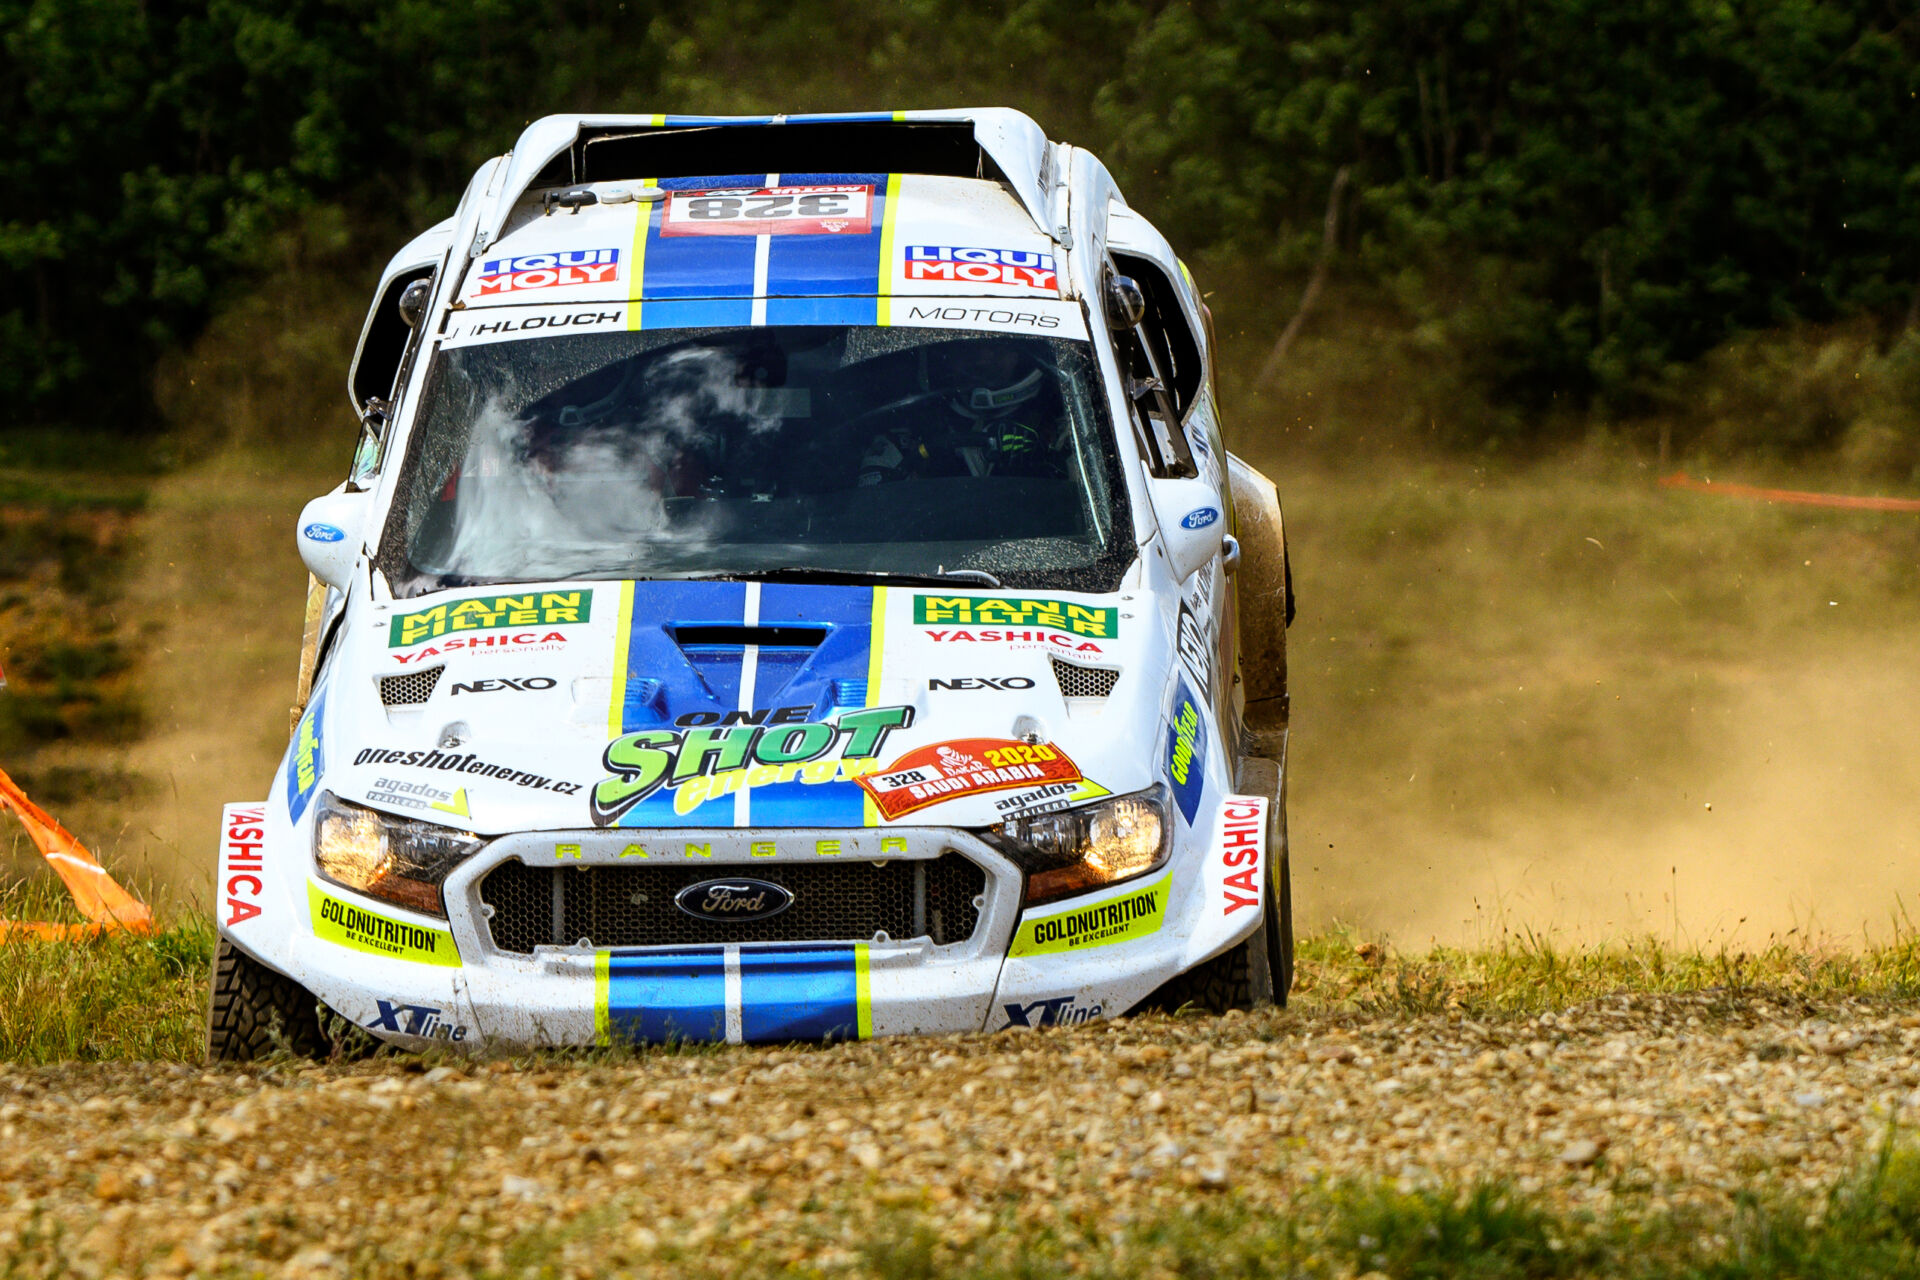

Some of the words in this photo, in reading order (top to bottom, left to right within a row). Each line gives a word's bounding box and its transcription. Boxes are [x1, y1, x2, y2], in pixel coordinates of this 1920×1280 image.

[768, 185, 861, 195] MOTUL
[688, 194, 849, 220] 328
[481, 249, 612, 276] LIQUI
[912, 246, 1053, 271] LIQUI
[474, 264, 615, 294] MOLY
[912, 261, 1056, 289] MOLY
[909, 306, 1060, 328] MOTORS
[306, 523, 337, 541] Ford
[1188, 509, 1213, 528] Ford
[402, 592, 581, 629] MANN
[925, 596, 1105, 623] MANN
[401, 607, 579, 645] FILTER
[925, 610, 1107, 637] FILTER
[392, 631, 567, 664] YASHICA
[924, 630, 1103, 653] YASHICA
[451, 677, 557, 696] NEXO
[928, 677, 1036, 690] NEXO
[674, 704, 816, 727] ONE
[983, 743, 1057, 768] 2020
[1170, 700, 1199, 786] GOODYEAR
[353, 747, 583, 796] oneshotenergy.cz
[591, 704, 915, 828] SHOT
[882, 770, 927, 788] 328
[942, 760, 989, 777] DAKAR
[374, 777, 452, 801] agados
[673, 757, 879, 817] energy
[909, 776, 971, 800] SAUDI
[970, 763, 1046, 786] ARABIA
[994, 782, 1079, 811] agados
[555, 836, 908, 860] RANGER
[1222, 798, 1261, 917] YASHICA
[226, 807, 265, 928] YASHICA
[701, 884, 766, 913] Ford
[320, 897, 436, 953] GOLDNUTRITION
[1034, 891, 1157, 945] GOLDNUTRITION
[345, 930, 356, 940] BE
[359, 935, 405, 955] EXCELLENT
[1068, 936, 1080, 947] BE
[1082, 922, 1130, 943] EXCELLENT
